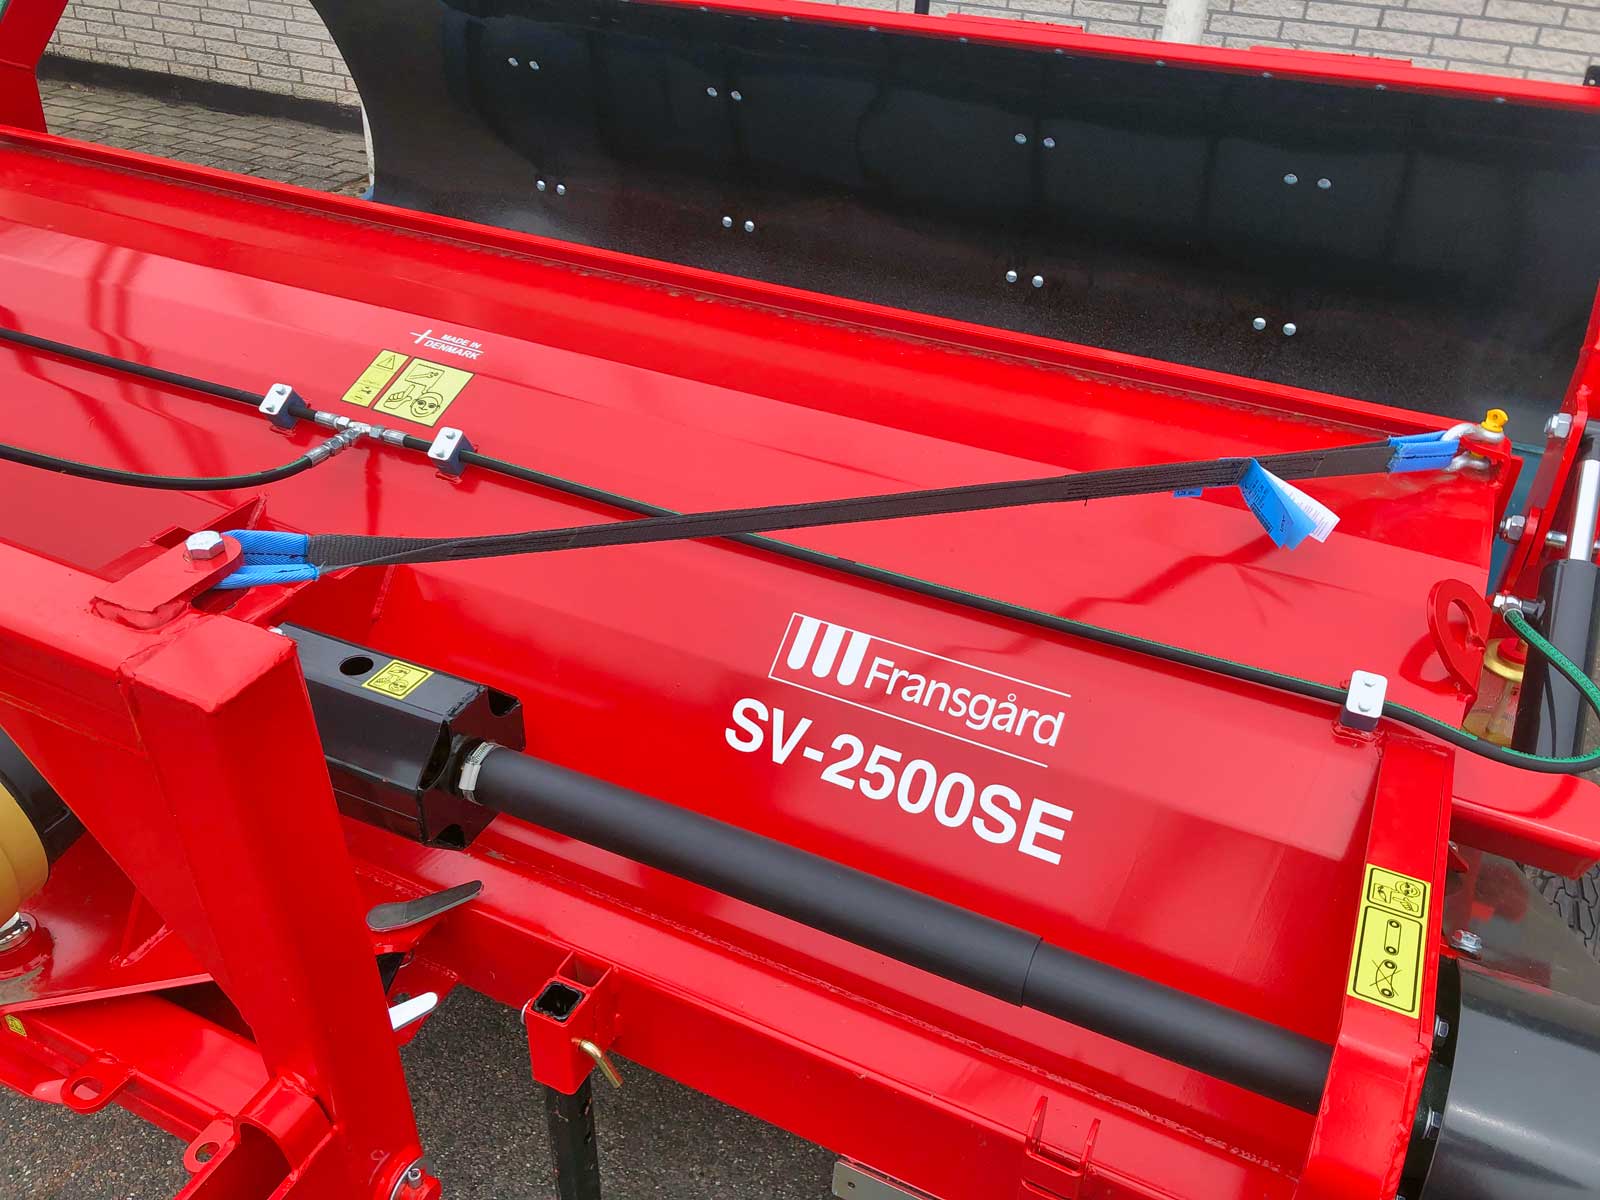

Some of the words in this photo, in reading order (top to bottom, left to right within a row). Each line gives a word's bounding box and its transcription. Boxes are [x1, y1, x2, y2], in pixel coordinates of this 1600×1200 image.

[424, 340, 480, 360] DENMARK
[441, 334, 469, 346] MADE
[864, 656, 1066, 747] Fransgård
[725, 697, 1074, 865] SV-2500SE
